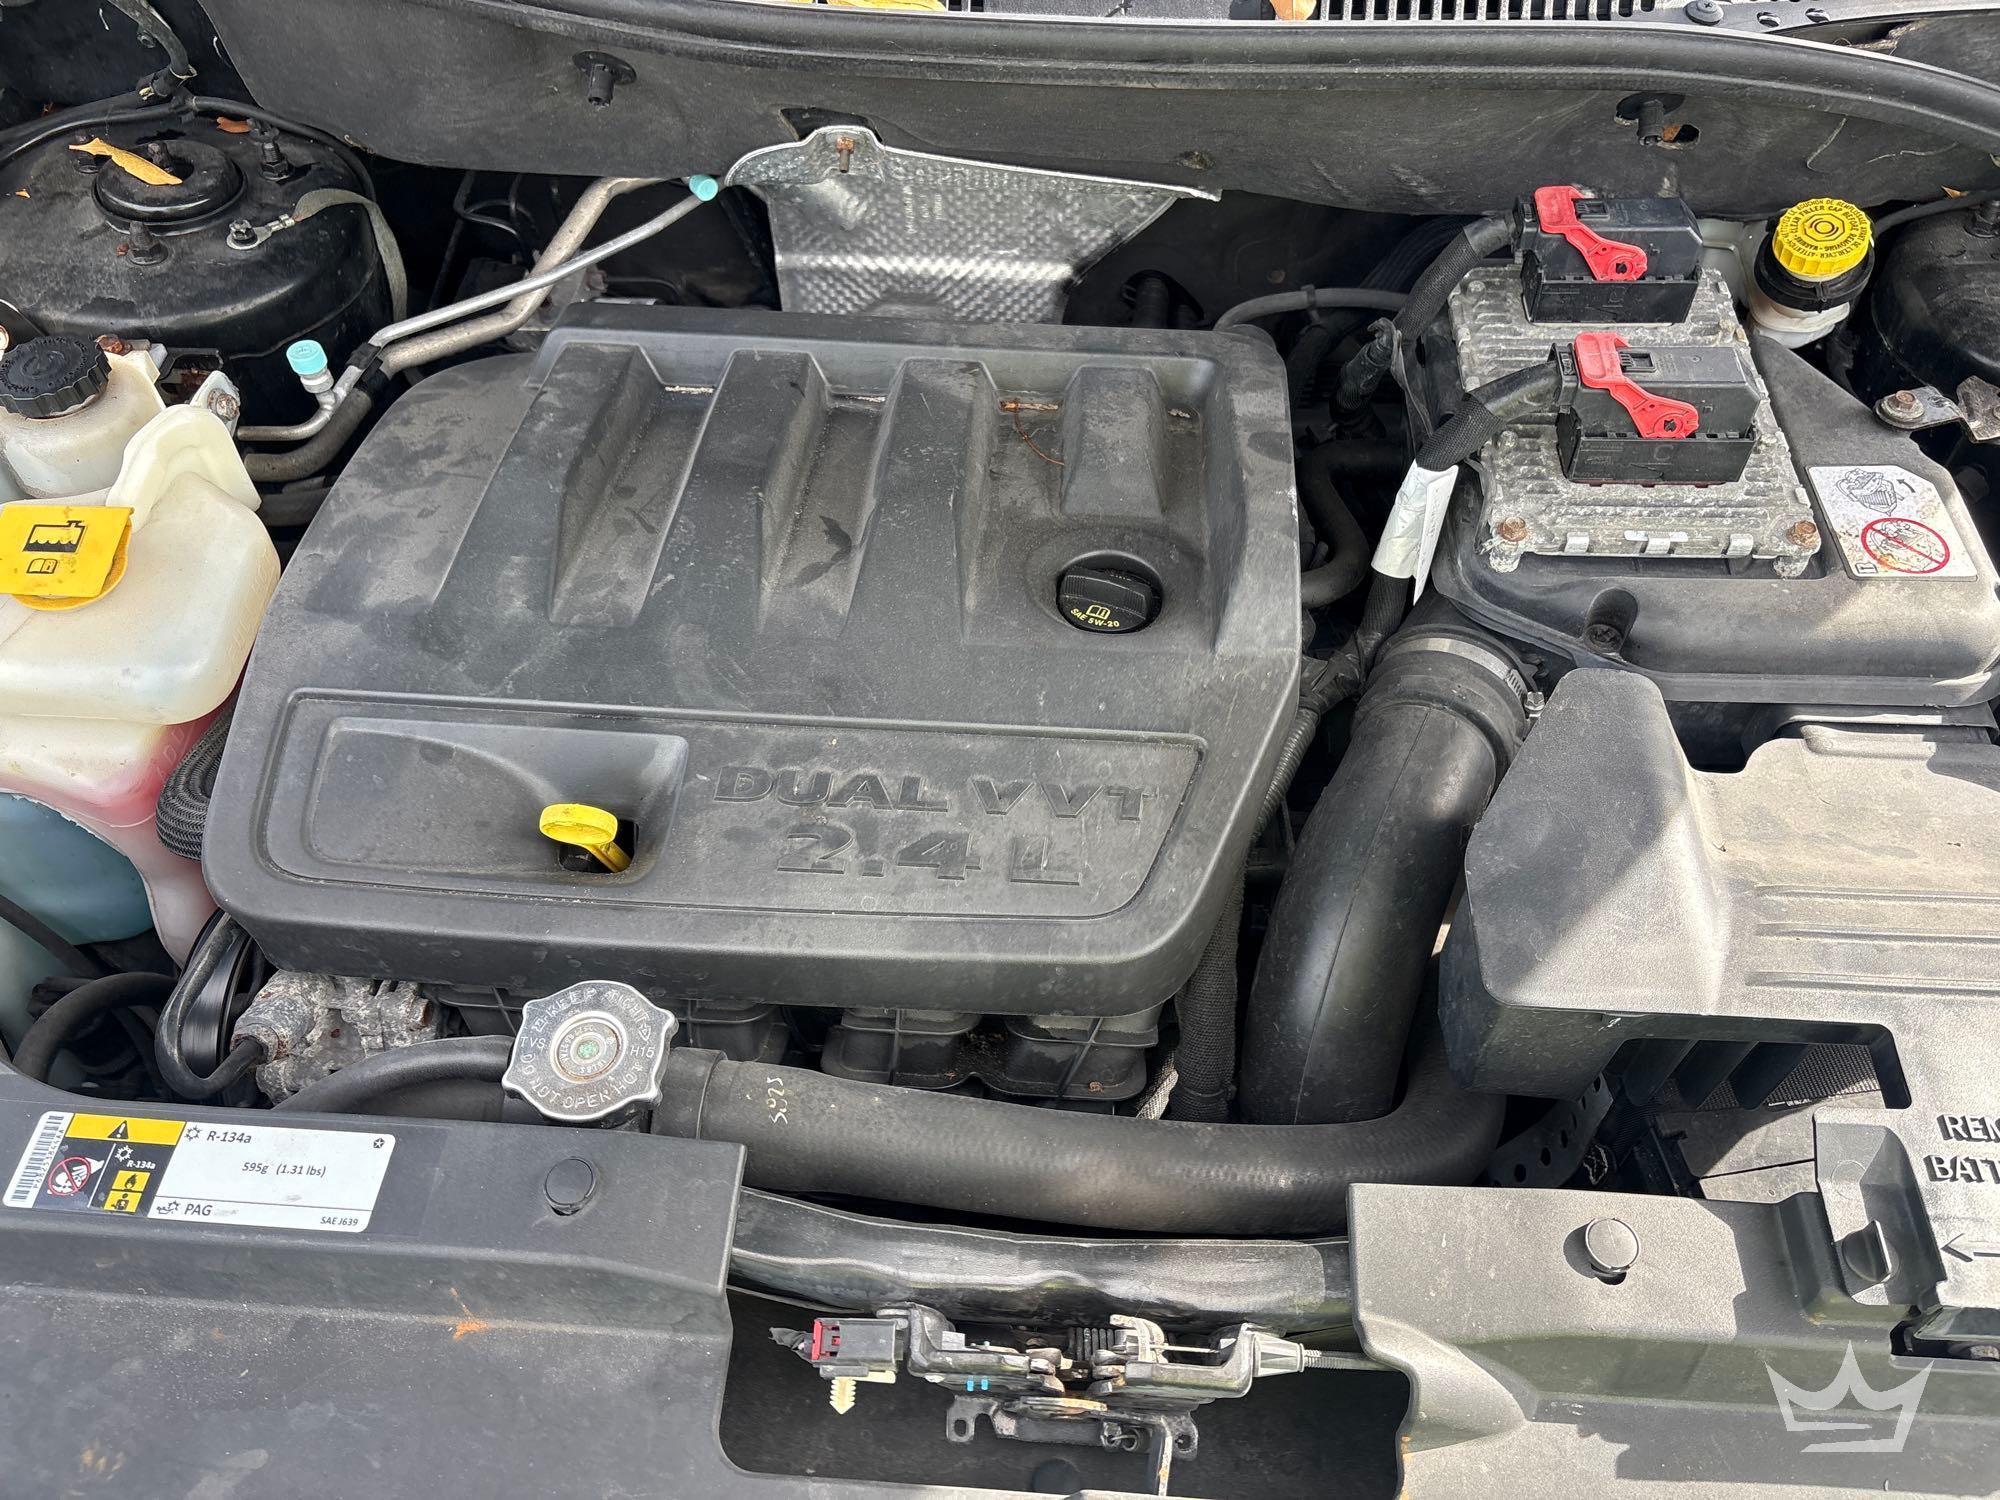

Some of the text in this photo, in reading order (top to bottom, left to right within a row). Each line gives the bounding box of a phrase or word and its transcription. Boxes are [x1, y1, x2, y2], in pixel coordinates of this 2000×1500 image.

[1799, 205, 1825, 217] FILLER
[1842, 211, 1859, 231] BEFORE
[1824, 233, 1857, 252] REMOVING
[1070, 608, 1120, 628] SAE 5W-20
[714, 766, 1159, 821] DUAL VVT
[206, 1130, 252, 1143] R-134a
[126, 1160, 156, 1170] R-134a
[242, 1162, 326, 1178] 595g (1.31 lbs)
[184, 1203, 213, 1216] PAG
[320, 1216, 359, 1227] SAE J639
